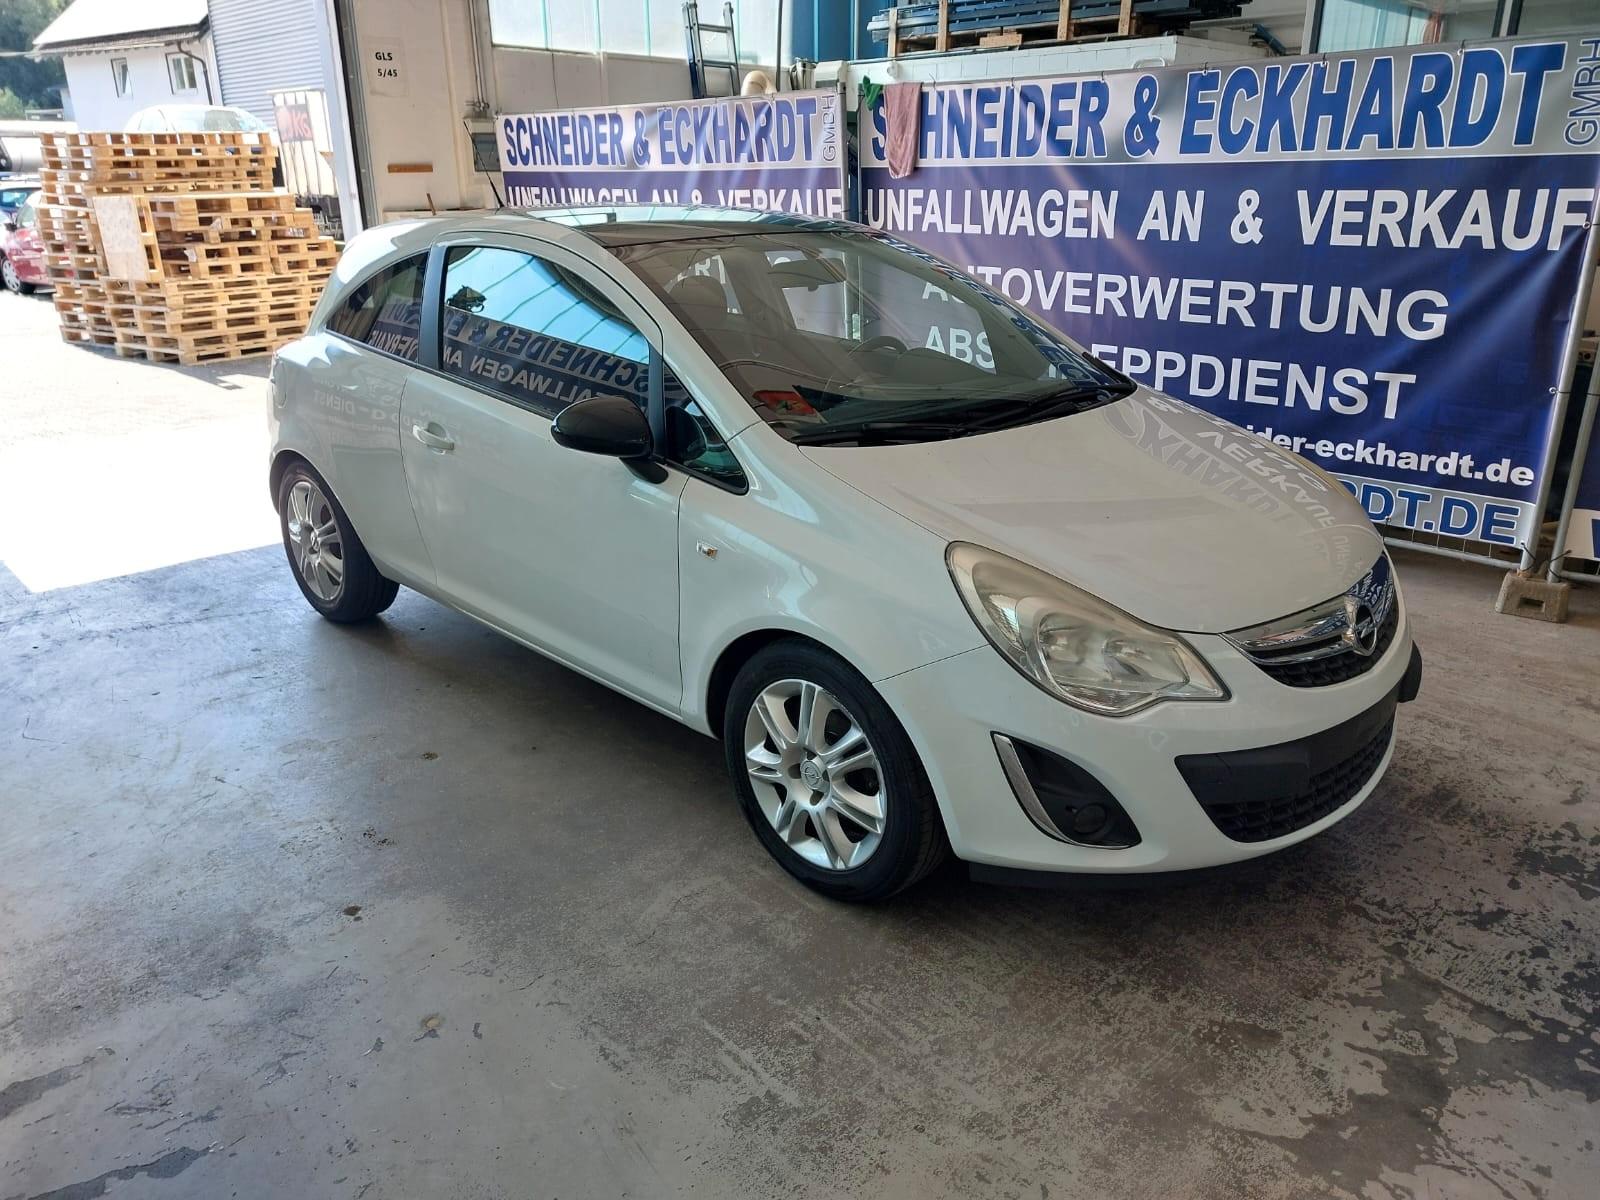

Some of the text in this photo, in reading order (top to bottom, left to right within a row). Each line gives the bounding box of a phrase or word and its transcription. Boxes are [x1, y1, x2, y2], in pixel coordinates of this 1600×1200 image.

[375, 51, 393, 61] GLS
[377, 68, 398, 78] 5/45
[503, 94, 836, 168] SCHNEIDER & ECKHARDT GMBH
[871, 37, 1600, 160] SHNEIDER & ECKHARDT GMBH
[867, 188, 1595, 251] UNFALLWAGEN AN & VERKAUF
[1338, 478, 1521, 546] DT.DE
